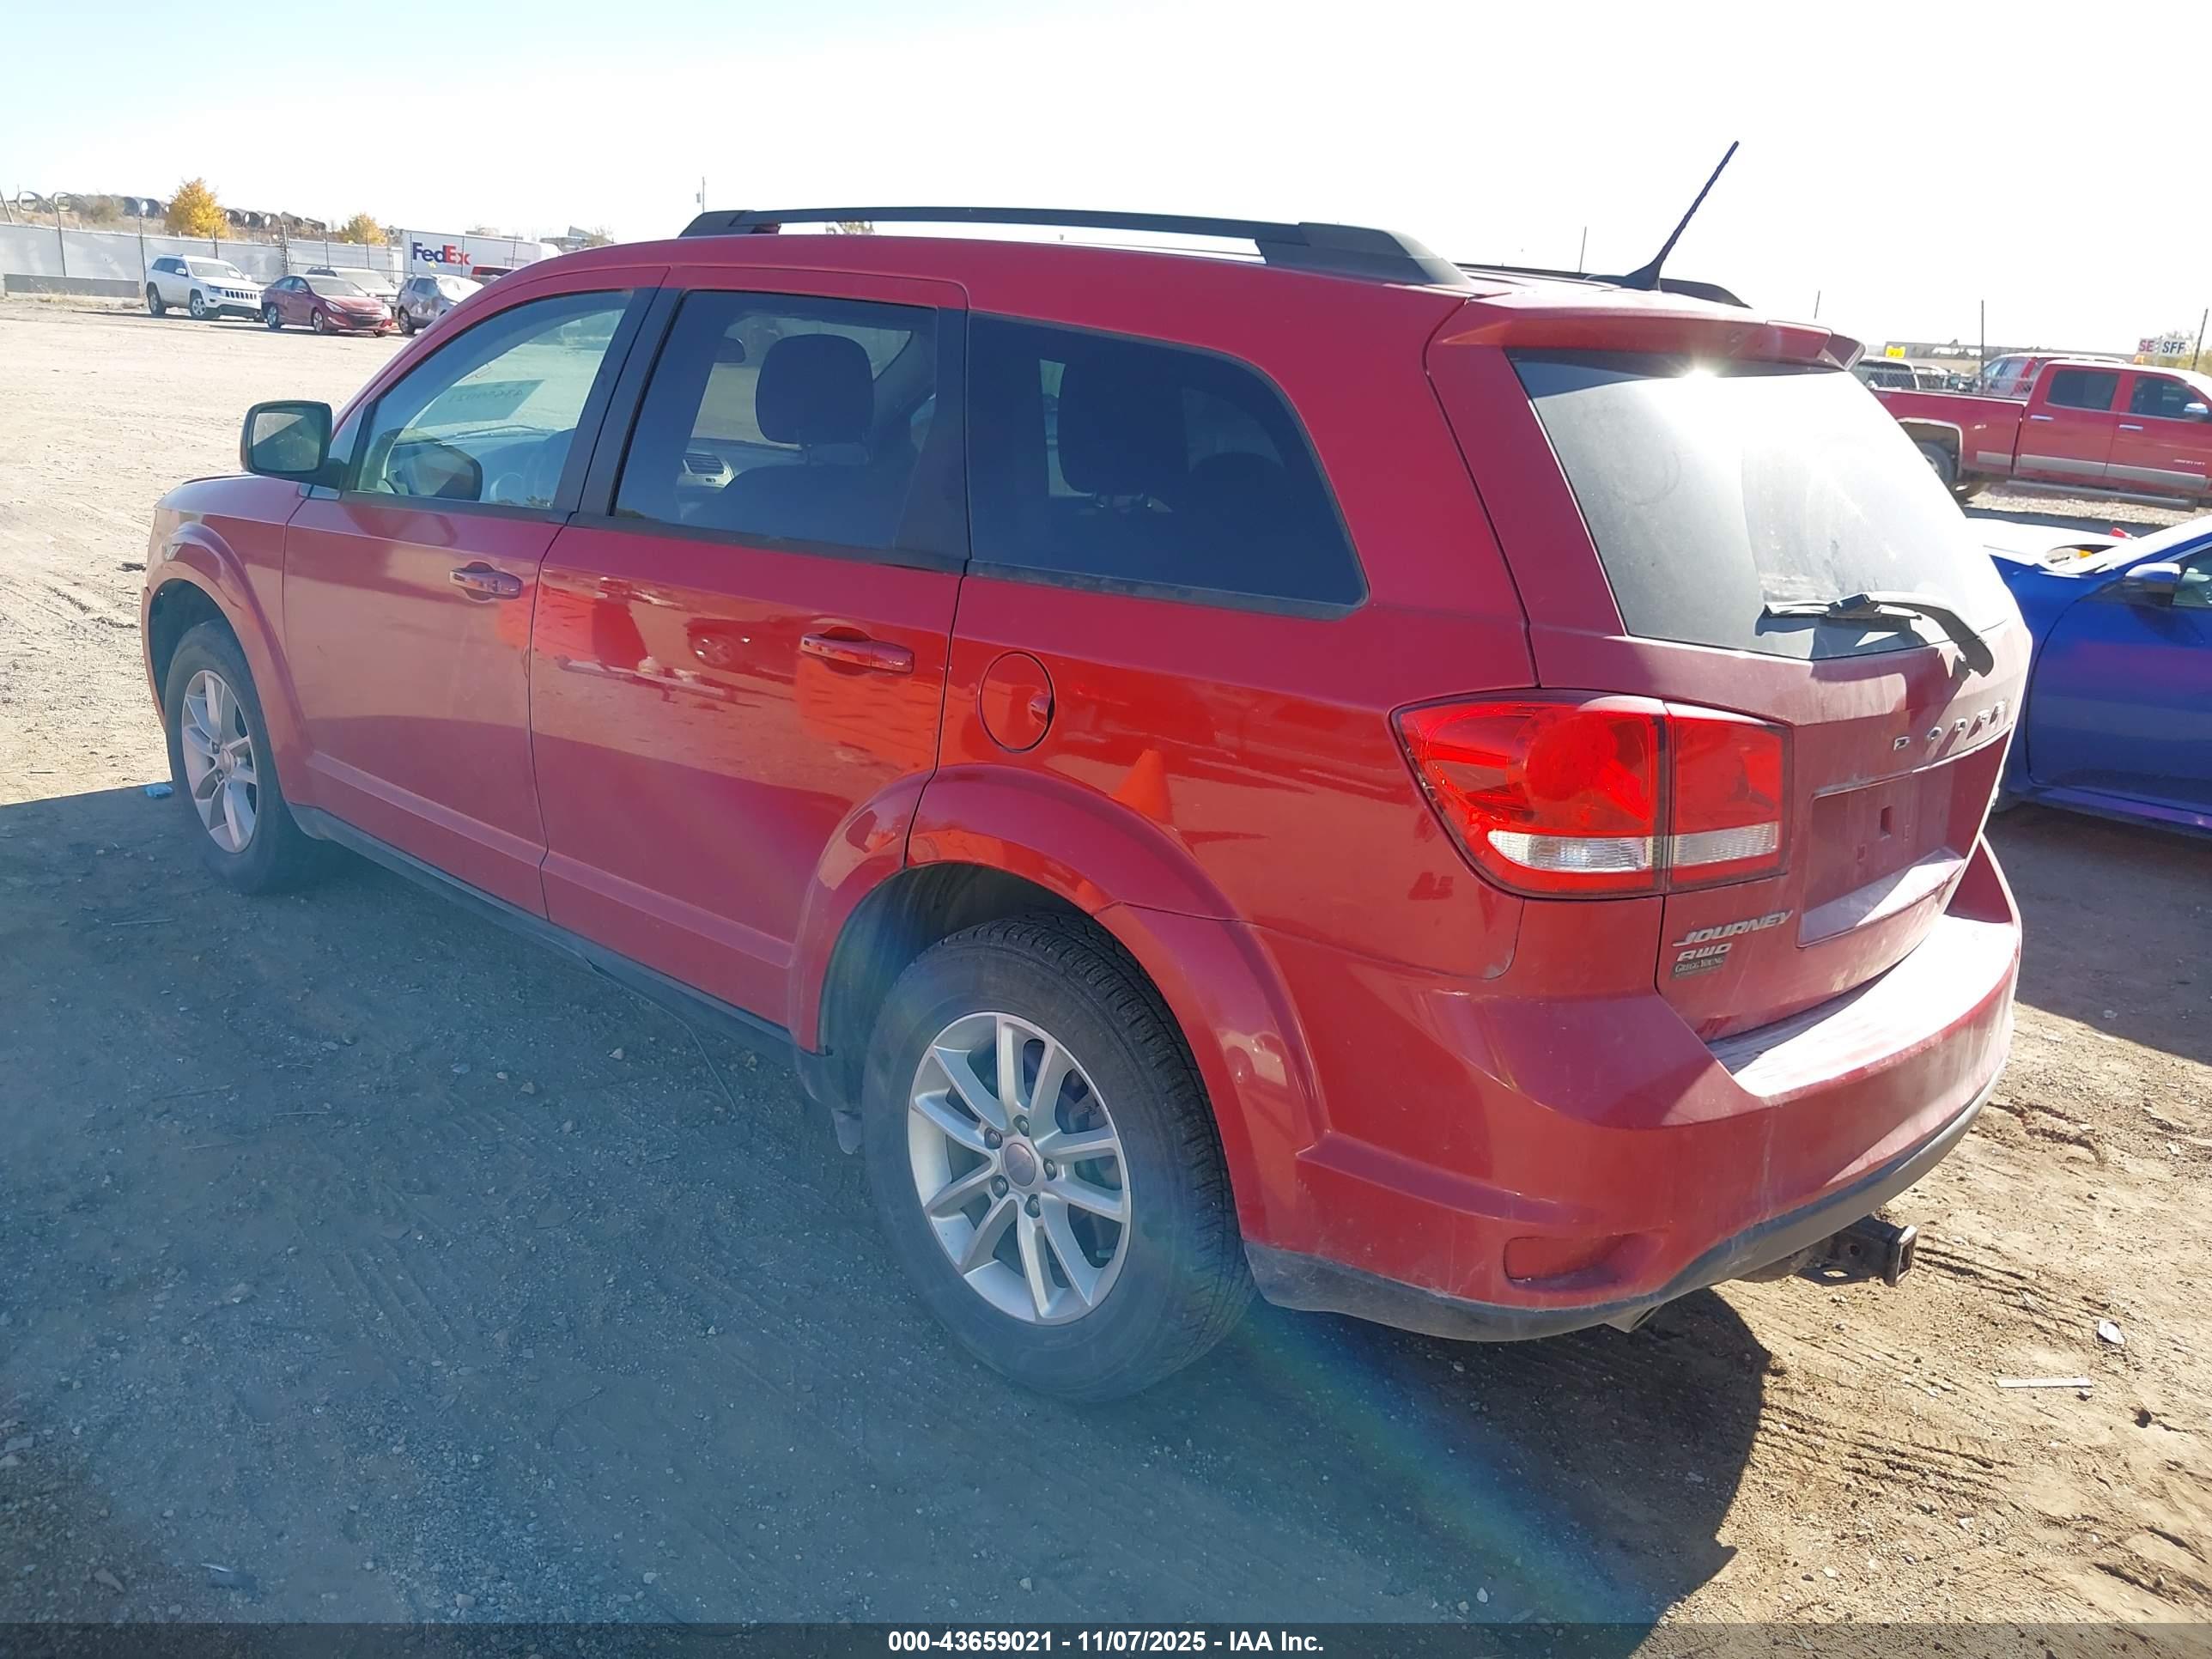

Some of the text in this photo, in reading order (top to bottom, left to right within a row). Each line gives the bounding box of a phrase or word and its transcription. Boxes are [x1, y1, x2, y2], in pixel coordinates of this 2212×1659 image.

[412, 241, 471, 265] FedEx
[2162, 341, 2186, 354] SFF
[1673, 909, 1794, 946] JOURNEY
[1677, 943, 1732, 962] AWD
